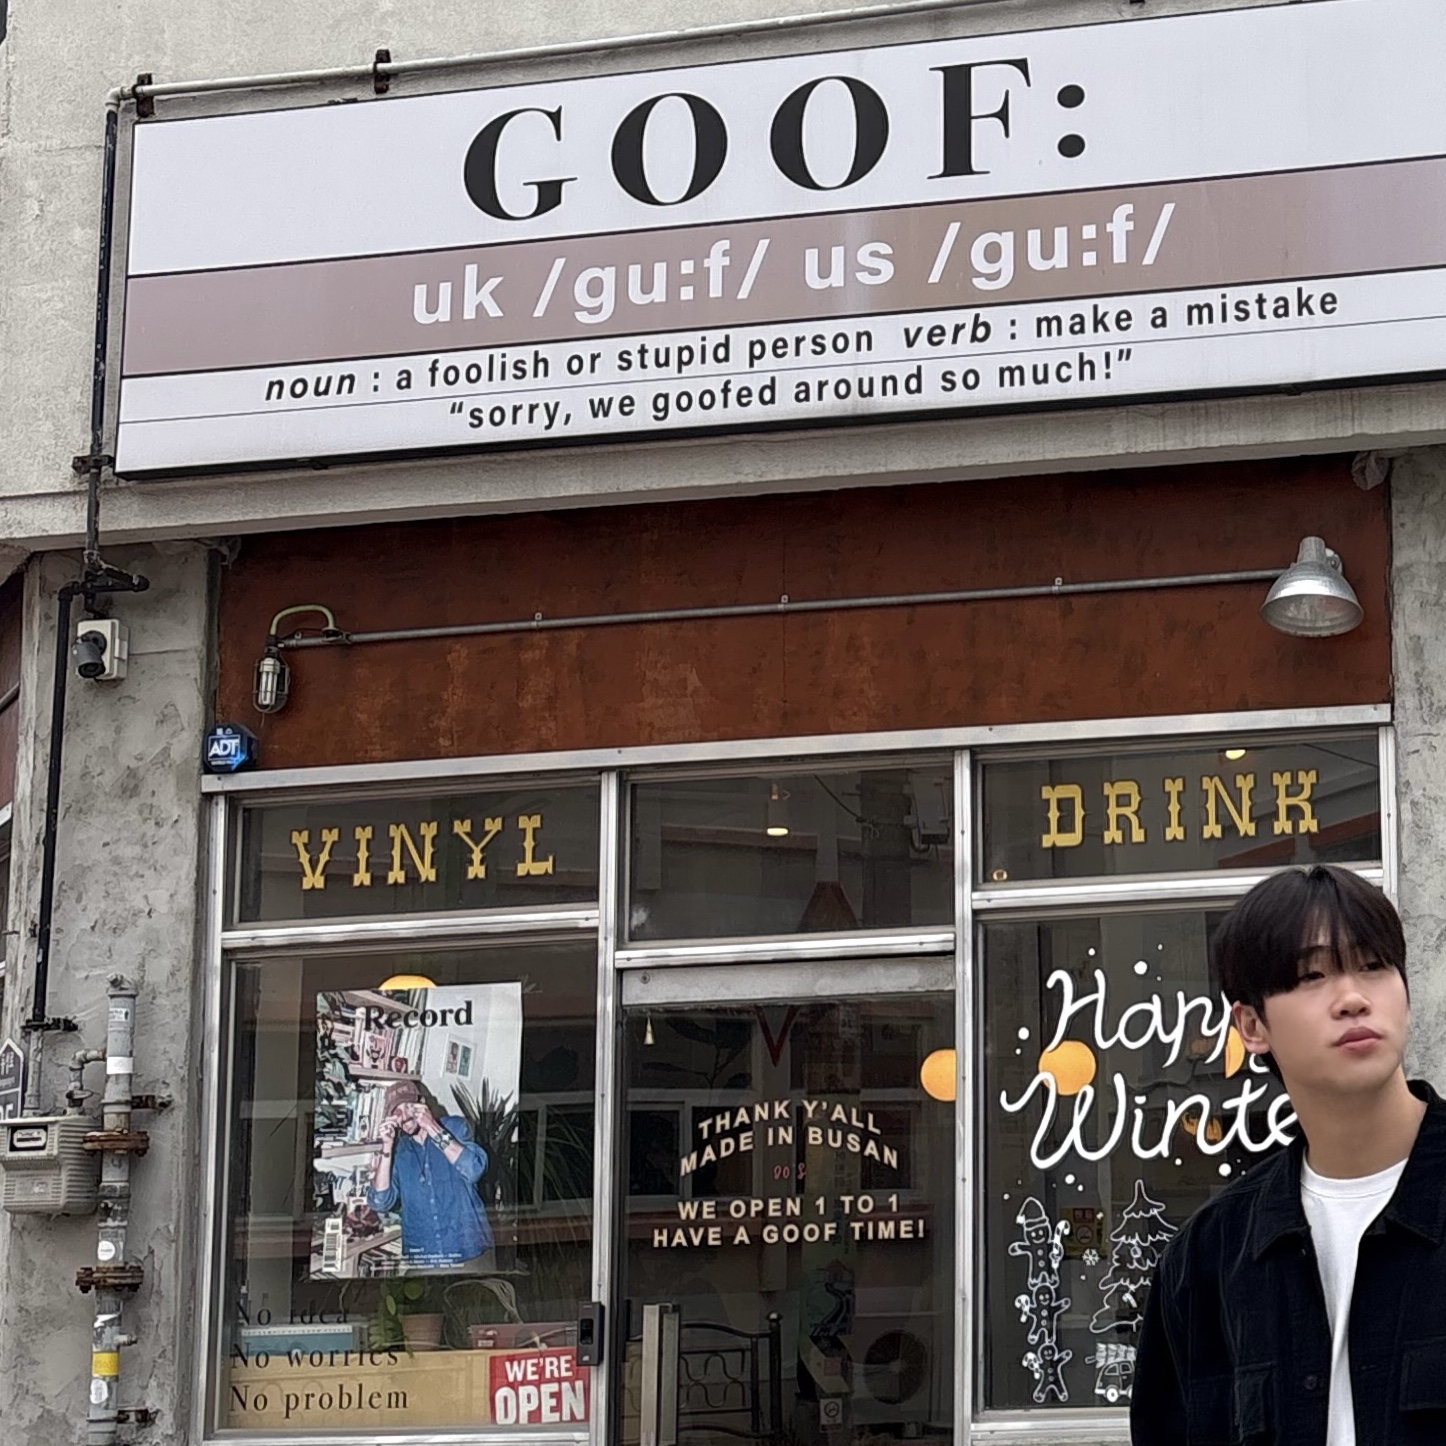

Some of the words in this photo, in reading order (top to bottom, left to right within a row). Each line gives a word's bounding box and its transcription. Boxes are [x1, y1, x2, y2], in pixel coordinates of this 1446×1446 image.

[463, 58, 1086, 221] GOOF:
[412, 263, 504, 325] uk
[532, 239, 771, 324] /gu:f/
[803, 239, 896, 289] us
[927, 203, 1177, 291] /gu:f/
[263, 369, 357, 402] noun
[395, 368, 413, 391] a
[428, 352, 550, 388] foolish
[566, 351, 602, 376] or
[616, 333, 733, 380] stupid
[748, 328, 875, 368] person
[903, 312, 993, 351] verb
[1035, 302, 1134, 342] make
[1150, 305, 1169, 331] a
[1187, 285, 1340, 327] mistake
[450, 400, 572, 430] “sorry,
[589, 393, 636, 419] we
[652, 374, 777, 421] goofed
[793, 356, 924, 404] around
[940, 366, 981, 394] so
[208, 739, 239, 756] ADT
[1041, 769, 1319, 849] DRINK
[291, 815, 554, 890] VINYL
[364, 1000, 474, 1032] Record
[699, 1100, 791, 1140] THANK
[802, 1101, 882, 1136] Y’ALL
[680, 1129, 755, 1177] MADE
[767, 1125, 794, 1146] IN
[807, 1126, 899, 1170] BUSAN
[678, 1200, 717, 1220] WE
[729, 1197, 802, 1219] OPEN
[815, 1196, 826, 1216] 1
[840, 1195, 876, 1214] TO
[889, 1193, 900, 1213] 1
[653, 1226, 722, 1248] HAVE
[734, 1225, 751, 1246] A
[762, 1222, 838, 1244] GOOF
[850, 1218, 926, 1242] TIME!
[236, 1300, 271, 1326] No
[230, 1341, 270, 1369] No
[229, 1384, 269, 1412] No
[284, 1382, 409, 1419] problem
[495, 1380, 585, 1425] OPEN
